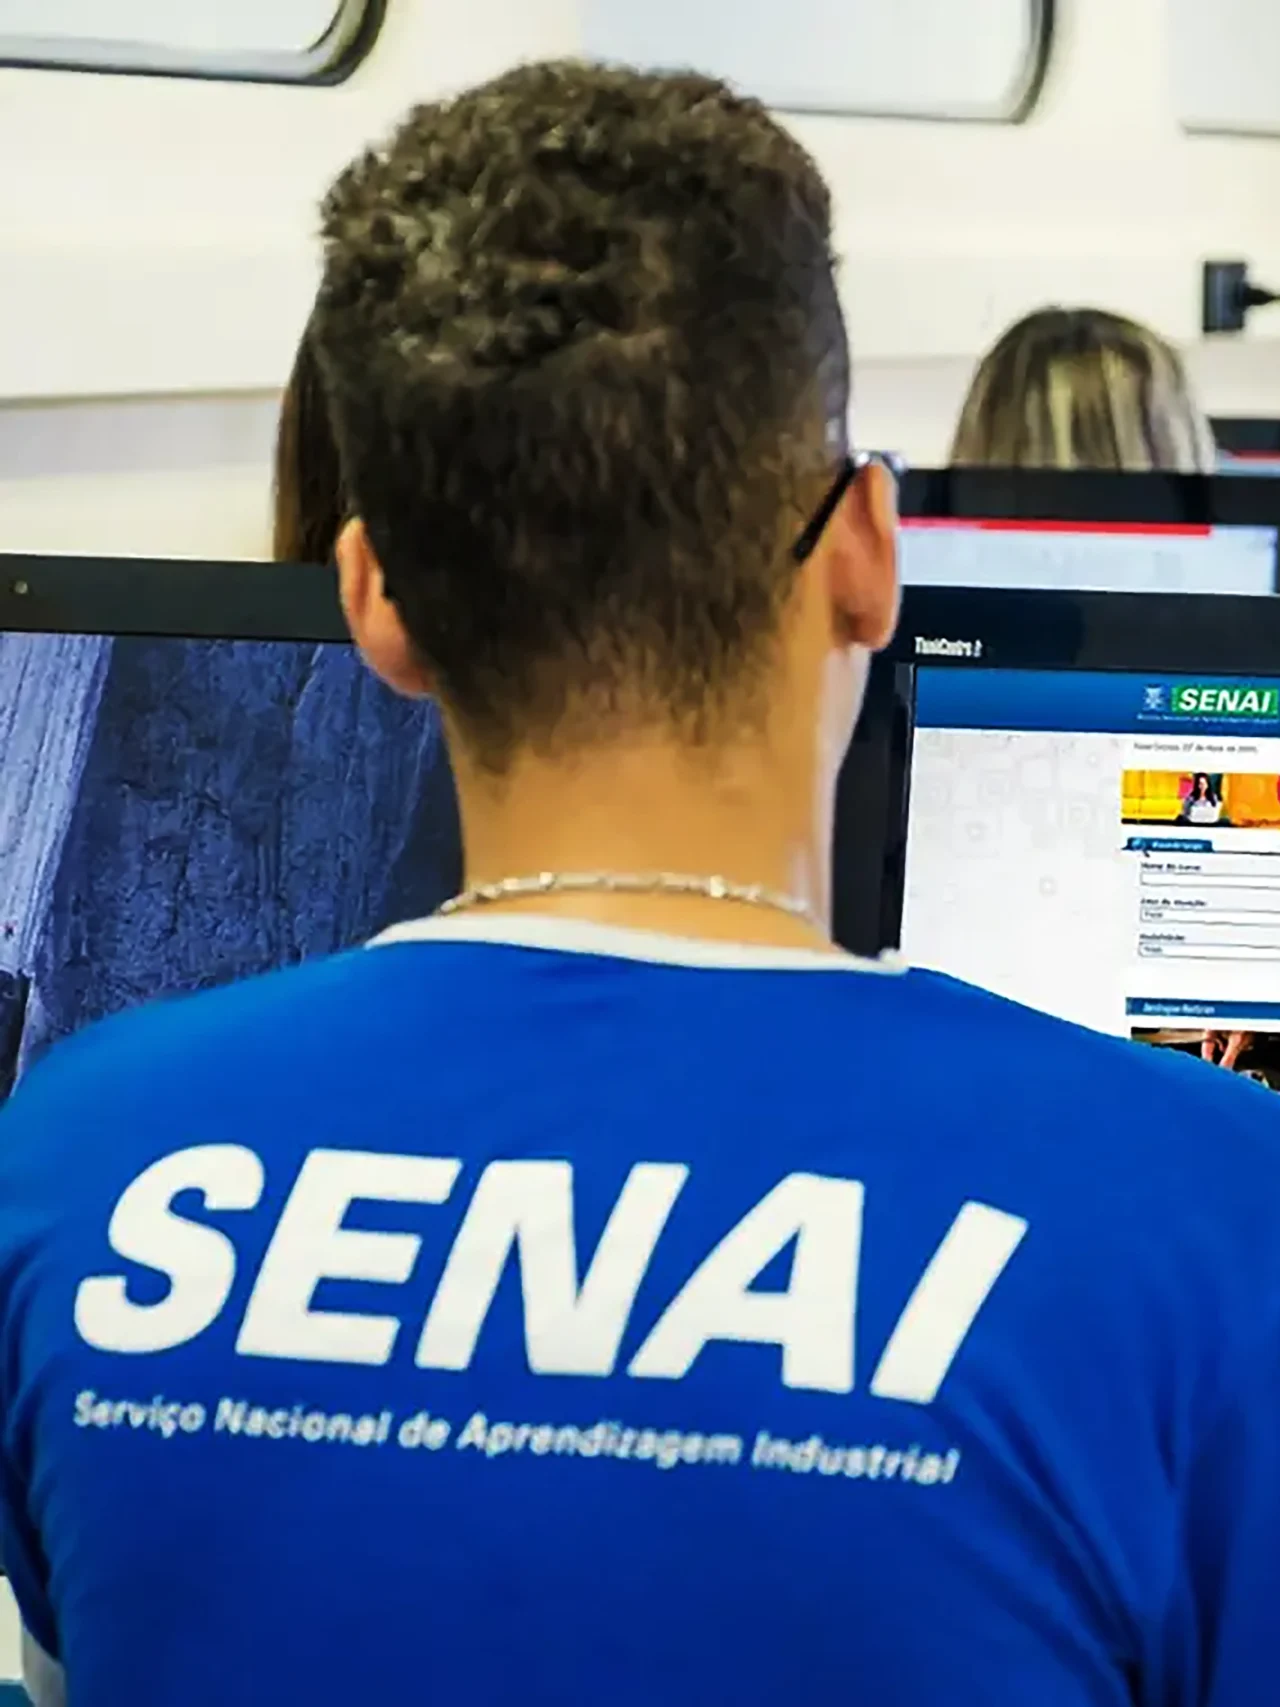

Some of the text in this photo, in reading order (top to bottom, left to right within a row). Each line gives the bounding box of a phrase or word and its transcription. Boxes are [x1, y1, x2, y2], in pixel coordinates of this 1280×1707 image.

[1178, 687, 1272, 713] SENAI
[73, 1142, 1030, 1405] SENAI
[73, 1390, 961, 1486] Serviço Nacional de Aprendizagem Industrial
